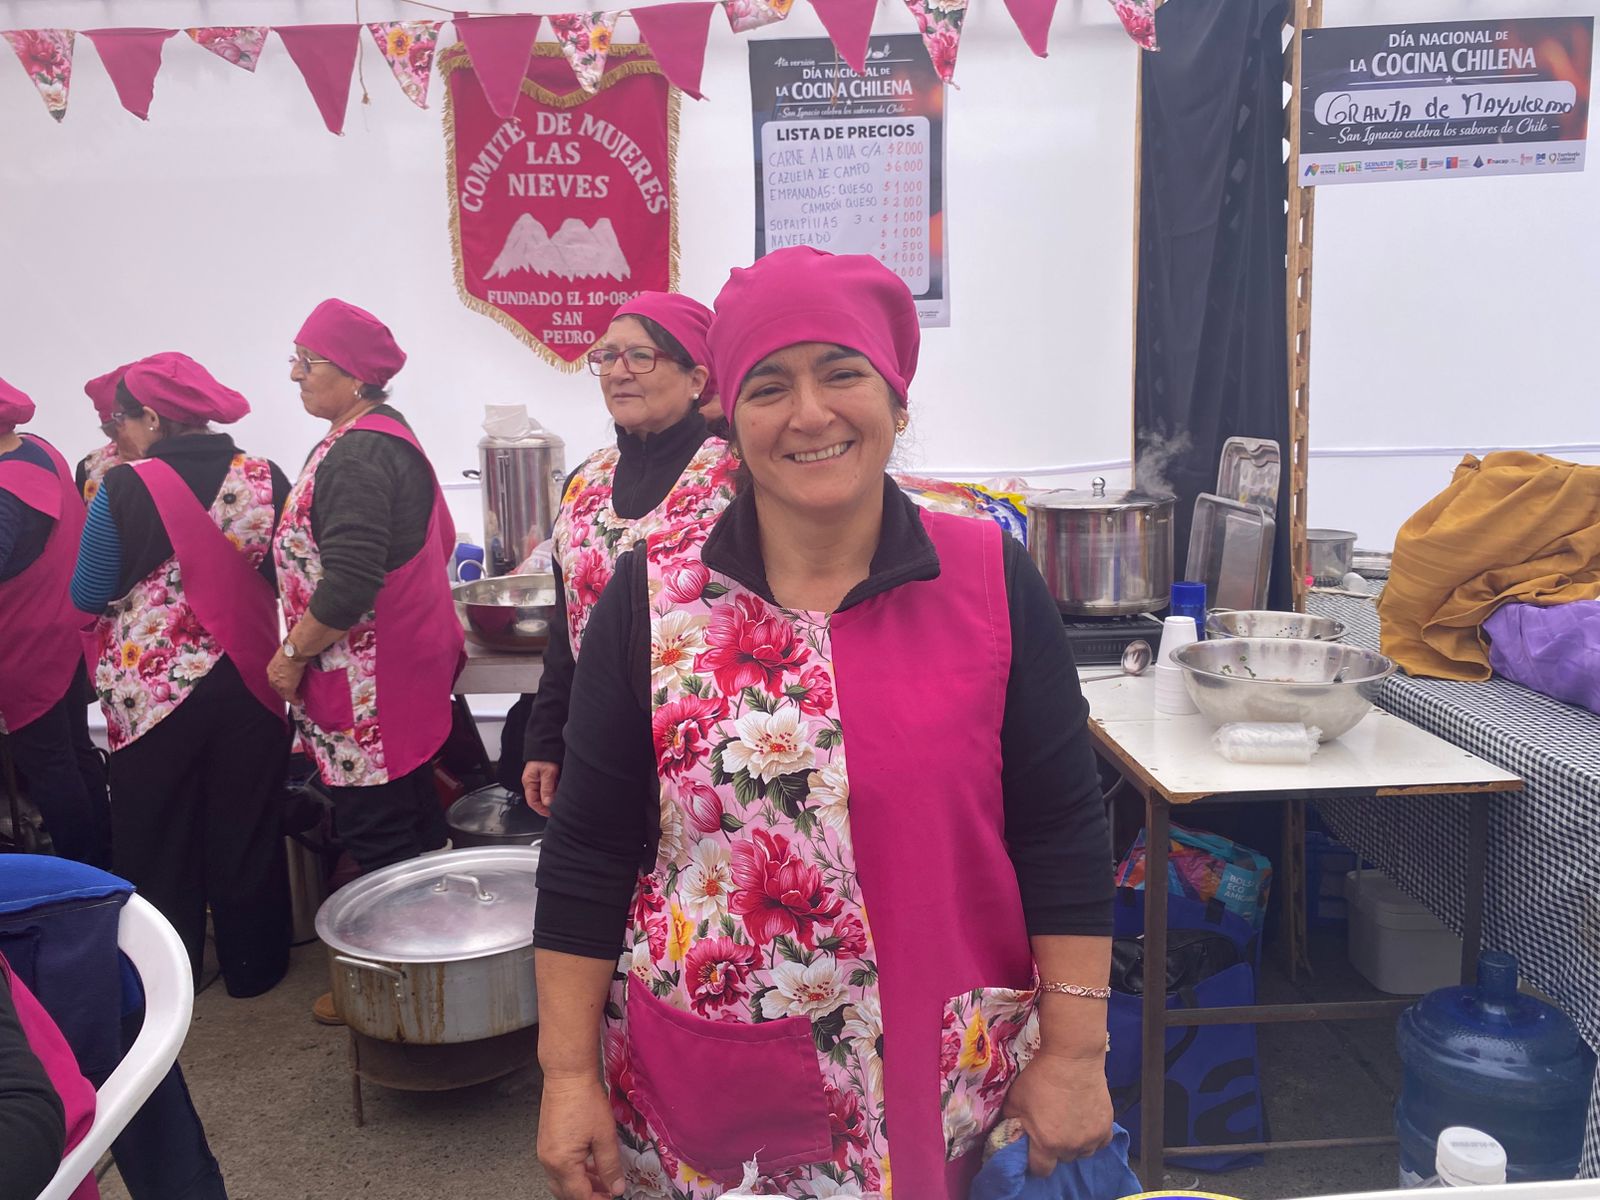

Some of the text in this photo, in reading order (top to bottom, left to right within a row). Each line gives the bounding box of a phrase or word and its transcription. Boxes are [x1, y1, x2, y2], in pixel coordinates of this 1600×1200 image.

[1389, 29, 1509, 48] DÍA NACIONAL DE
[1350, 47, 1537, 77] LA COCINA CHILENA
[802, 66, 891, 80] DÍA NACIOAL DE
[776, 79, 913, 100] LA COCINA CHILENA
[796, 108, 820, 120] Ignacio
[821, 105, 843, 116] celebra
[853, 105, 877, 115] sabores
[877, 104, 886, 114] de
[886, 103, 905, 114] Chile
[1425, 96, 1450, 119] de
[777, 124, 915, 141] LISTA DE PRECIOS
[1337, 118, 1548, 145] San Ignacio celebra los sabores de Chile
[526, 141, 582, 165] LAS
[768, 149, 806, 168] CARNE
[461, 111, 669, 215] COMITE DE MUJERES
[833, 162, 871, 180] CAMPO
[508, 173, 610, 198] NIEVES
[838, 183, 874, 196] QUESO
[845, 196, 878, 209] QUESO
[487, 290, 563, 306] FUNDADO
[566, 291, 584, 306] EL
[551, 312, 583, 326] SAN
[542, 330, 596, 345] PEDRO
[1226, 882, 1245, 894] ECO
